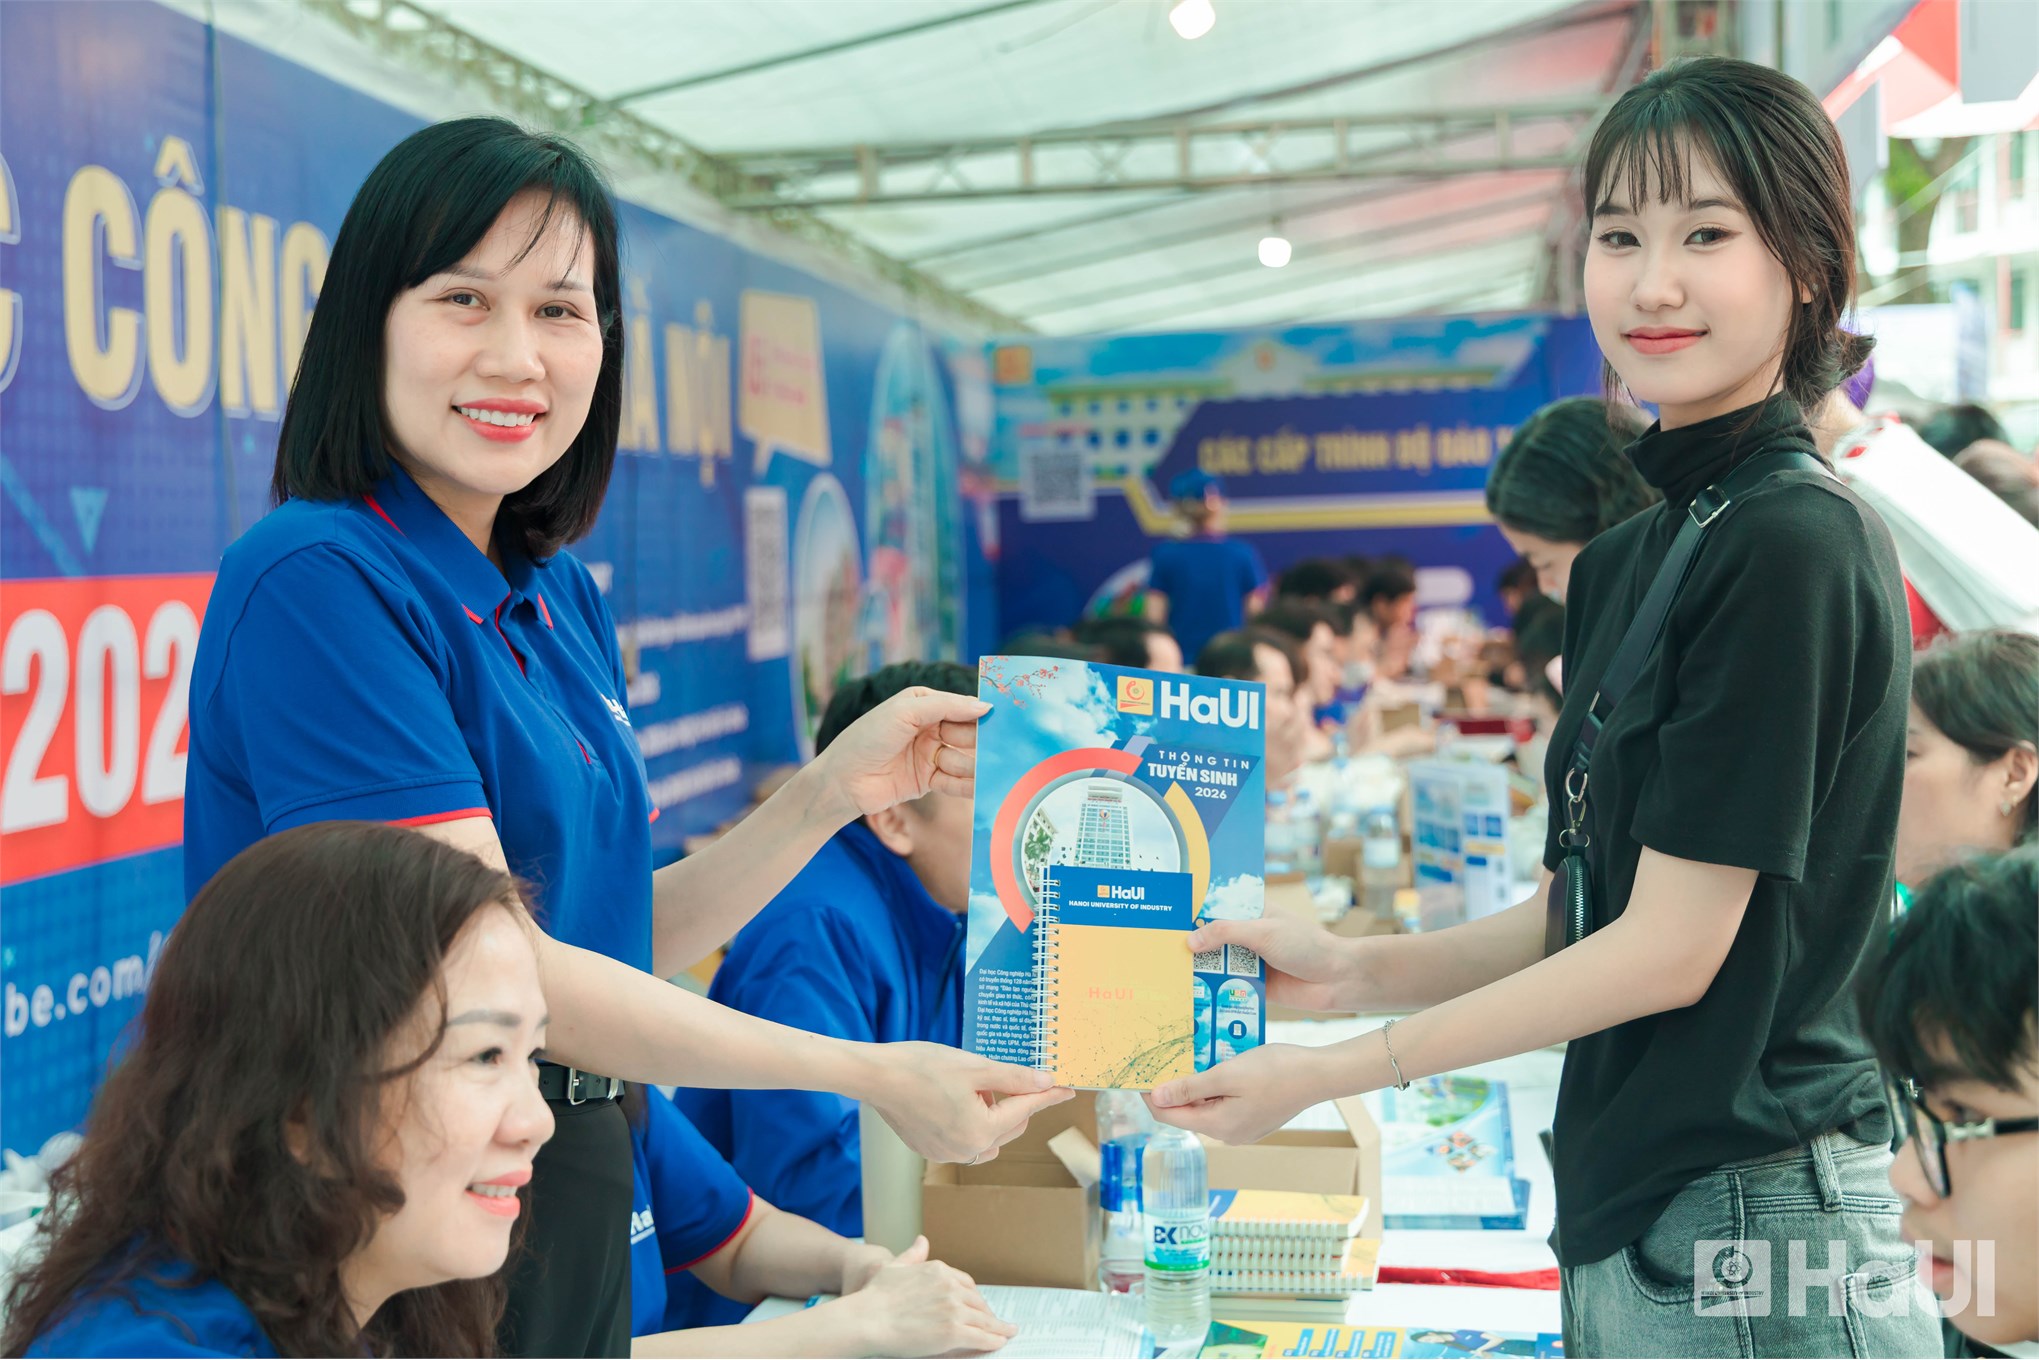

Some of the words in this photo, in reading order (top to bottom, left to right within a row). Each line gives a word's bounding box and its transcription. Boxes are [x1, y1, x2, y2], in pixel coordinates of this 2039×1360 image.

[1160, 680, 1260, 730] HaUI
[1159, 750, 1218, 766] THÔNG
[1223, 758, 1251, 770] TIN
[1147, 761, 1198, 782] TUYỂN
[1200, 768, 1238, 787] SINH
[1194, 786, 1228, 800] 2026
[1111, 885, 1146, 900] HaUI
[1068, 900, 1090, 908] HANOI
[1090, 901, 1129, 909] UNIVERSITY
[1140, 904, 1173, 912] INDUSTRY
[1088, 986, 1135, 1000] HaUI
[1154, 1226, 1178, 1245] BK
